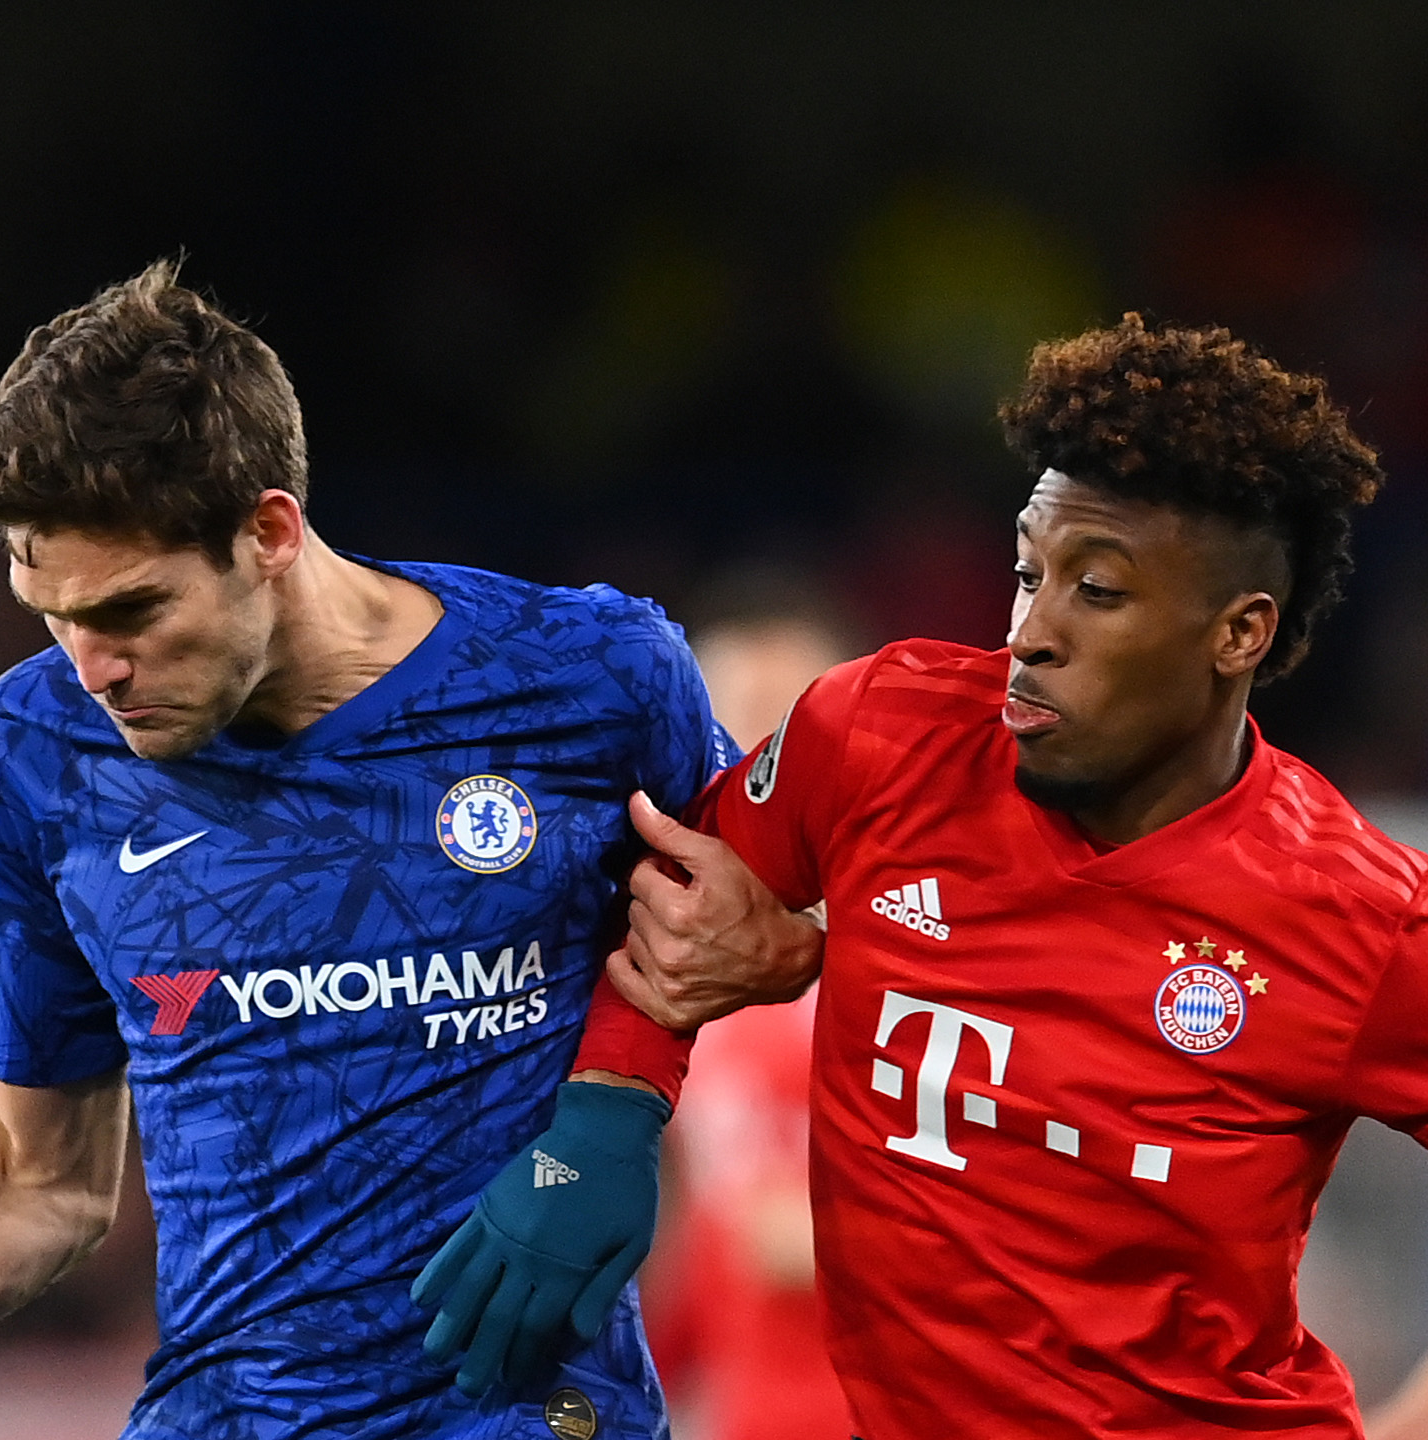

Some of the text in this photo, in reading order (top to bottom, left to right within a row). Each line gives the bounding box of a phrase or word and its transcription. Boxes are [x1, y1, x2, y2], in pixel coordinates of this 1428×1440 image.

[450, 779, 514, 802] CHELSEA
[457, 847, 524, 868] FOOTBALL CLUB
[870, 896, 951, 941] adidas
[219, 940, 545, 1023] YOKOHAMA
[1168, 970, 1239, 1015] FC BAYERN
[423, 988, 548, 1050] TYRES
[873, 990, 1015, 1171] T
[531, 1149, 580, 1181] adidas
